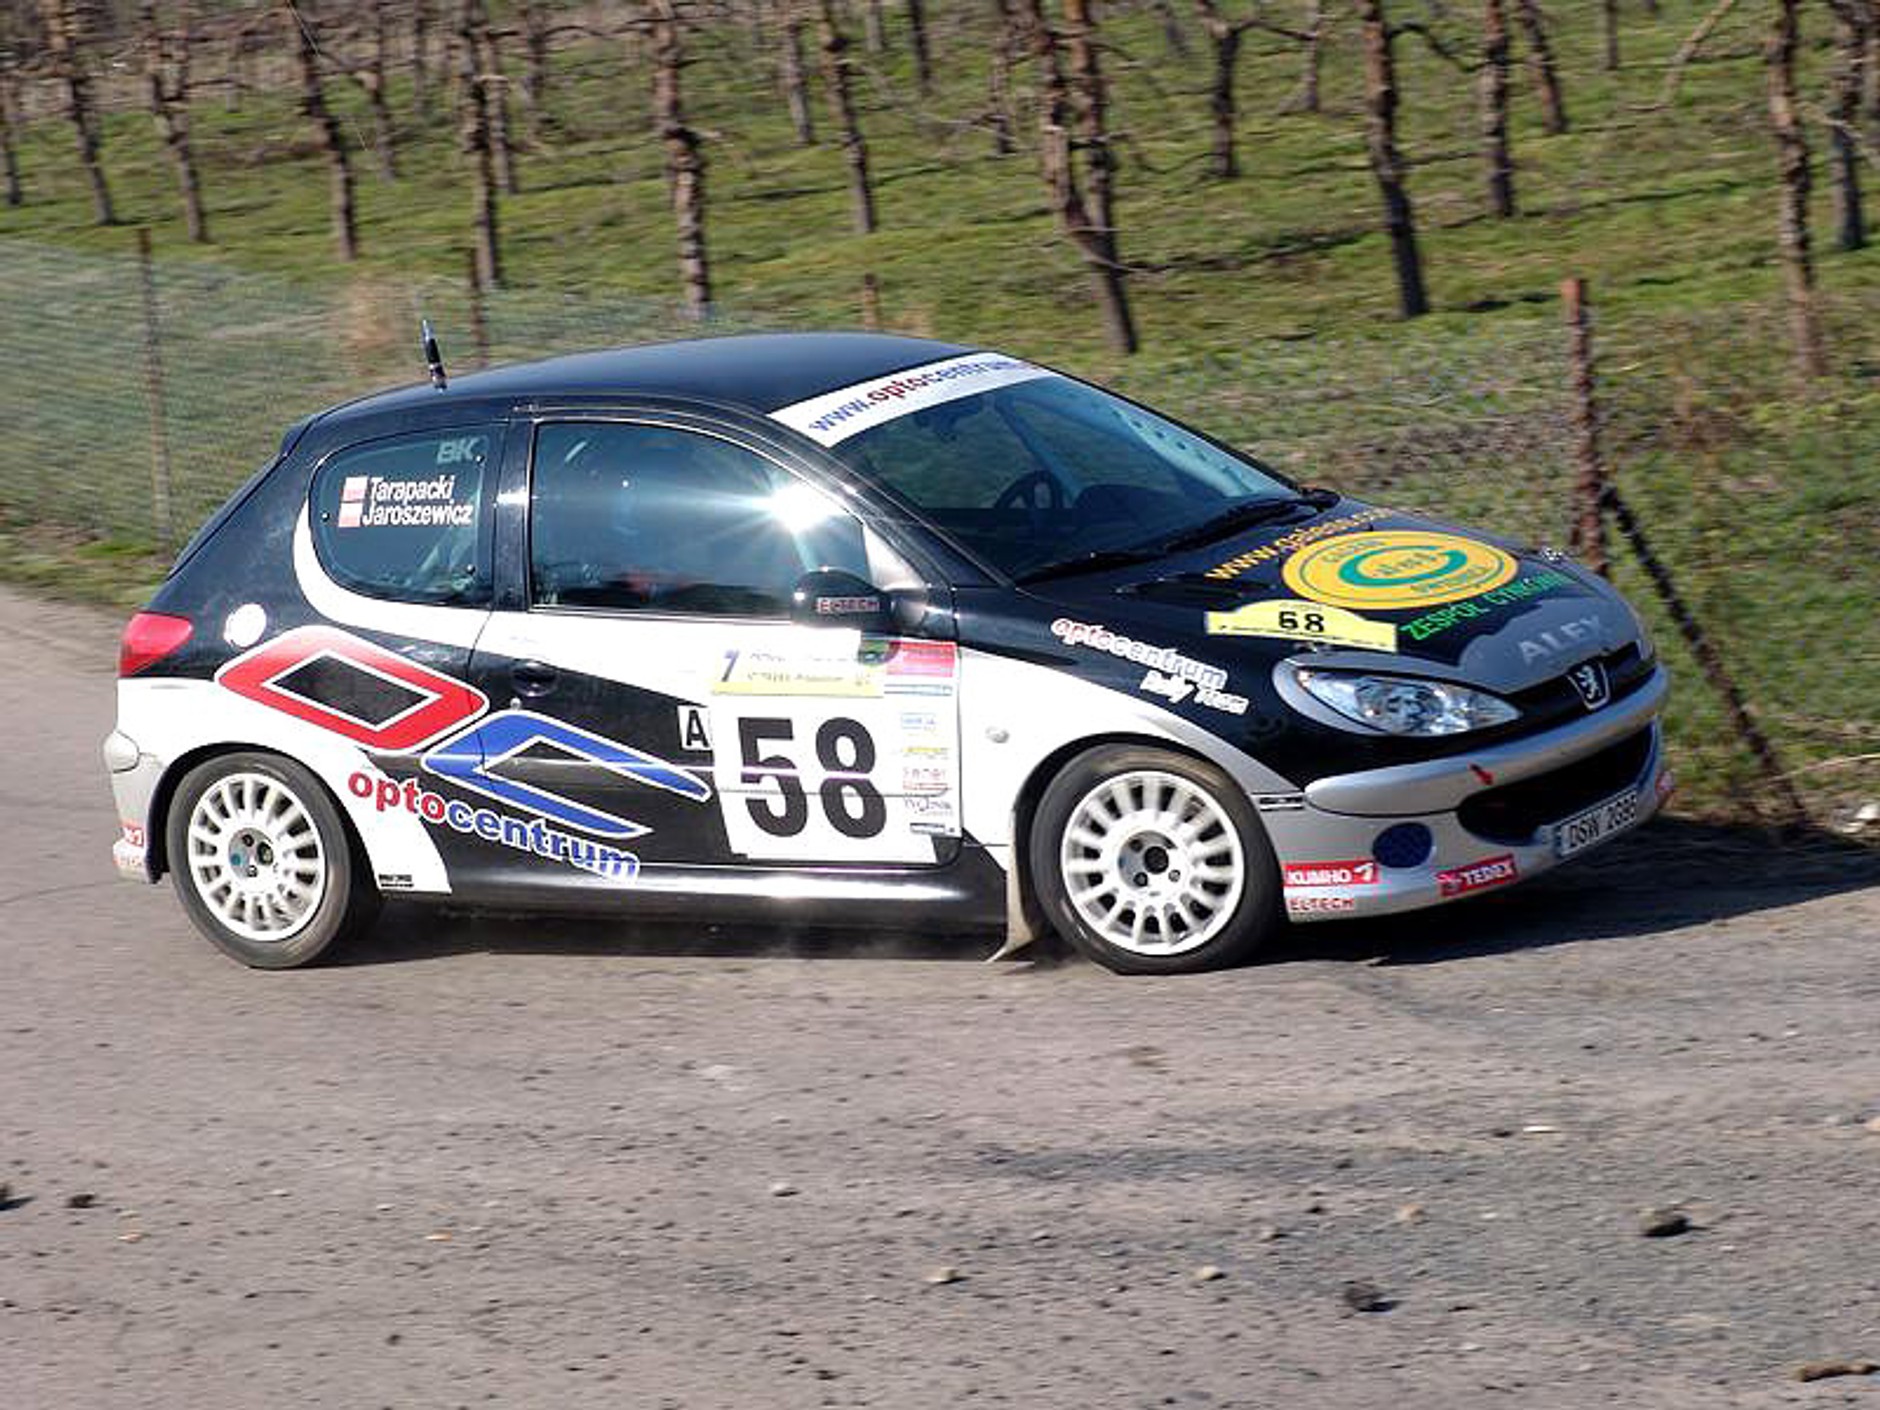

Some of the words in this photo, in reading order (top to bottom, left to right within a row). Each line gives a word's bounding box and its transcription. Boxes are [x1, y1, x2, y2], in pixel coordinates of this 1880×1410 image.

[369, 474, 456, 506] Tarapacki
[362, 498, 474, 526] Jaroszewicz
[1051, 618, 1228, 689] optocentrum
[685, 709, 709, 747] A
[737, 716, 887, 839] 58
[347, 770, 640, 881] optocentrum
[1286, 868, 1352, 885] KUMHO
